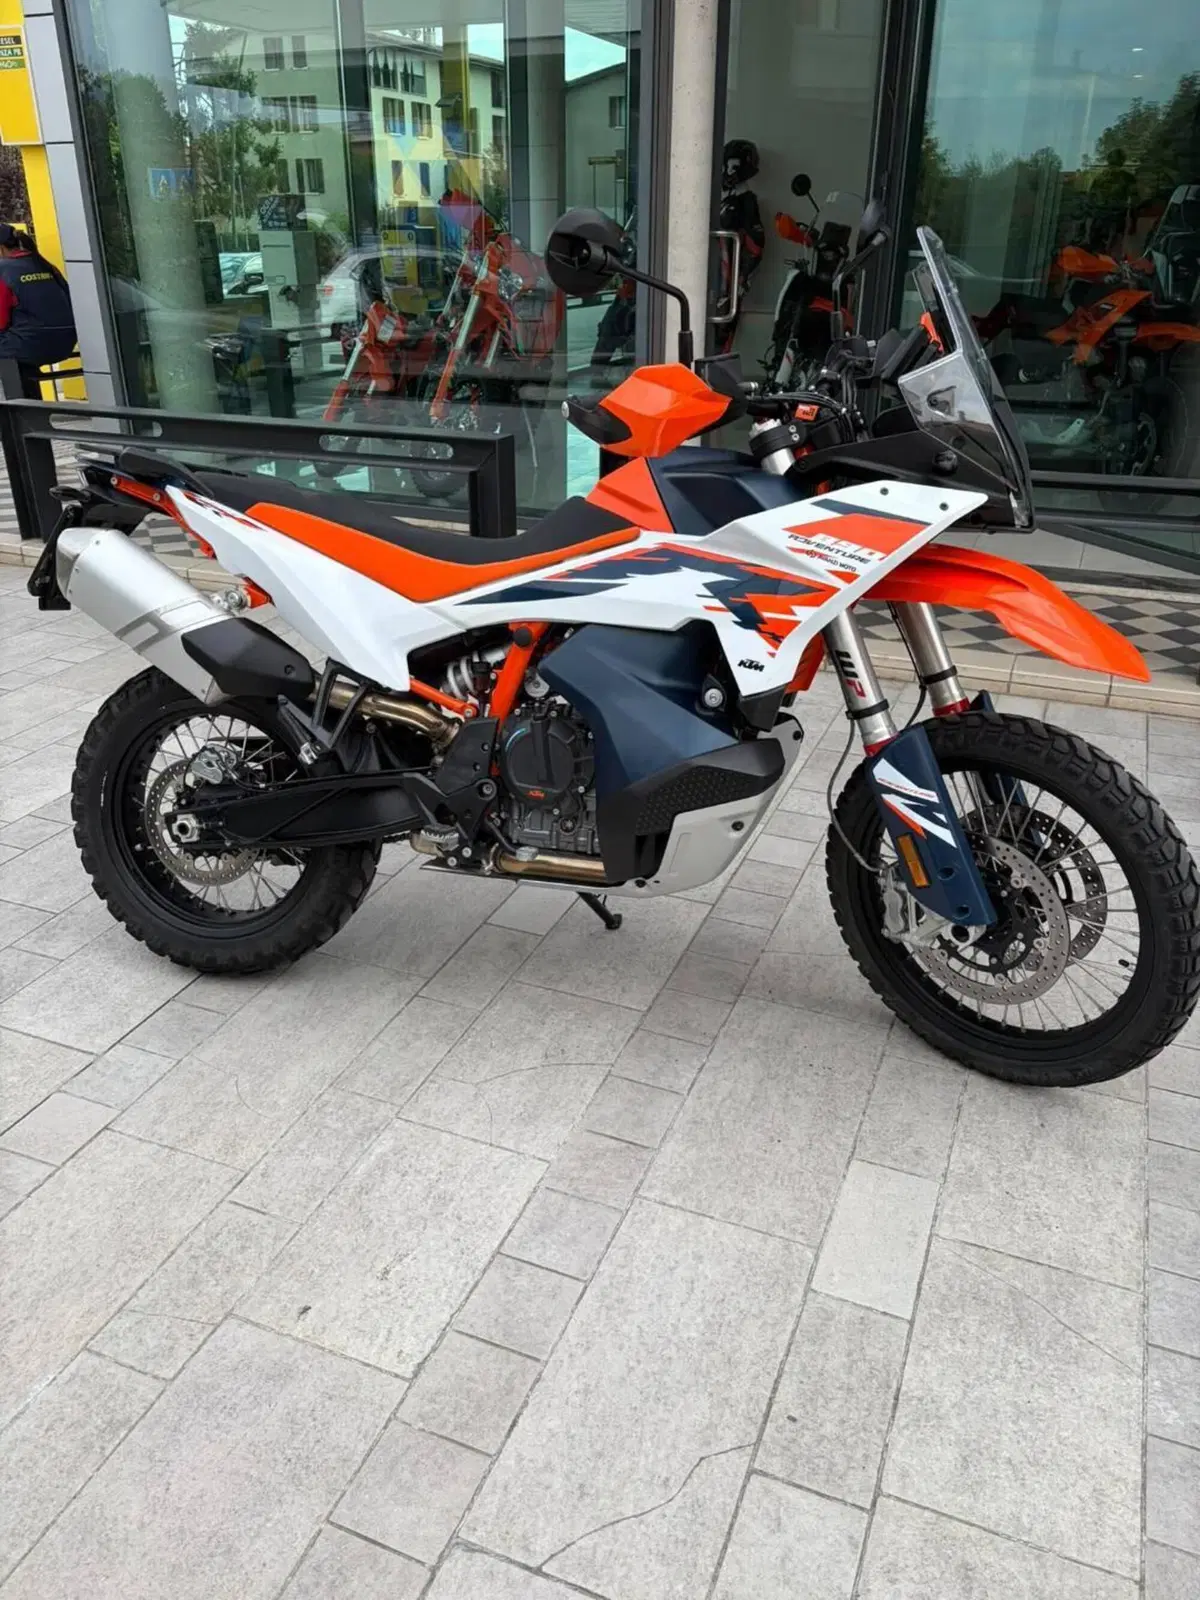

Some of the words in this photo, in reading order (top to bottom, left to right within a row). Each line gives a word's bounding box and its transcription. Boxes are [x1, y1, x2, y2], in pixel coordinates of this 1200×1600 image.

[788, 533, 871, 564] ADVENTURE
[737, 659, 765, 672] KTM
[834, 650, 866, 698] WP
